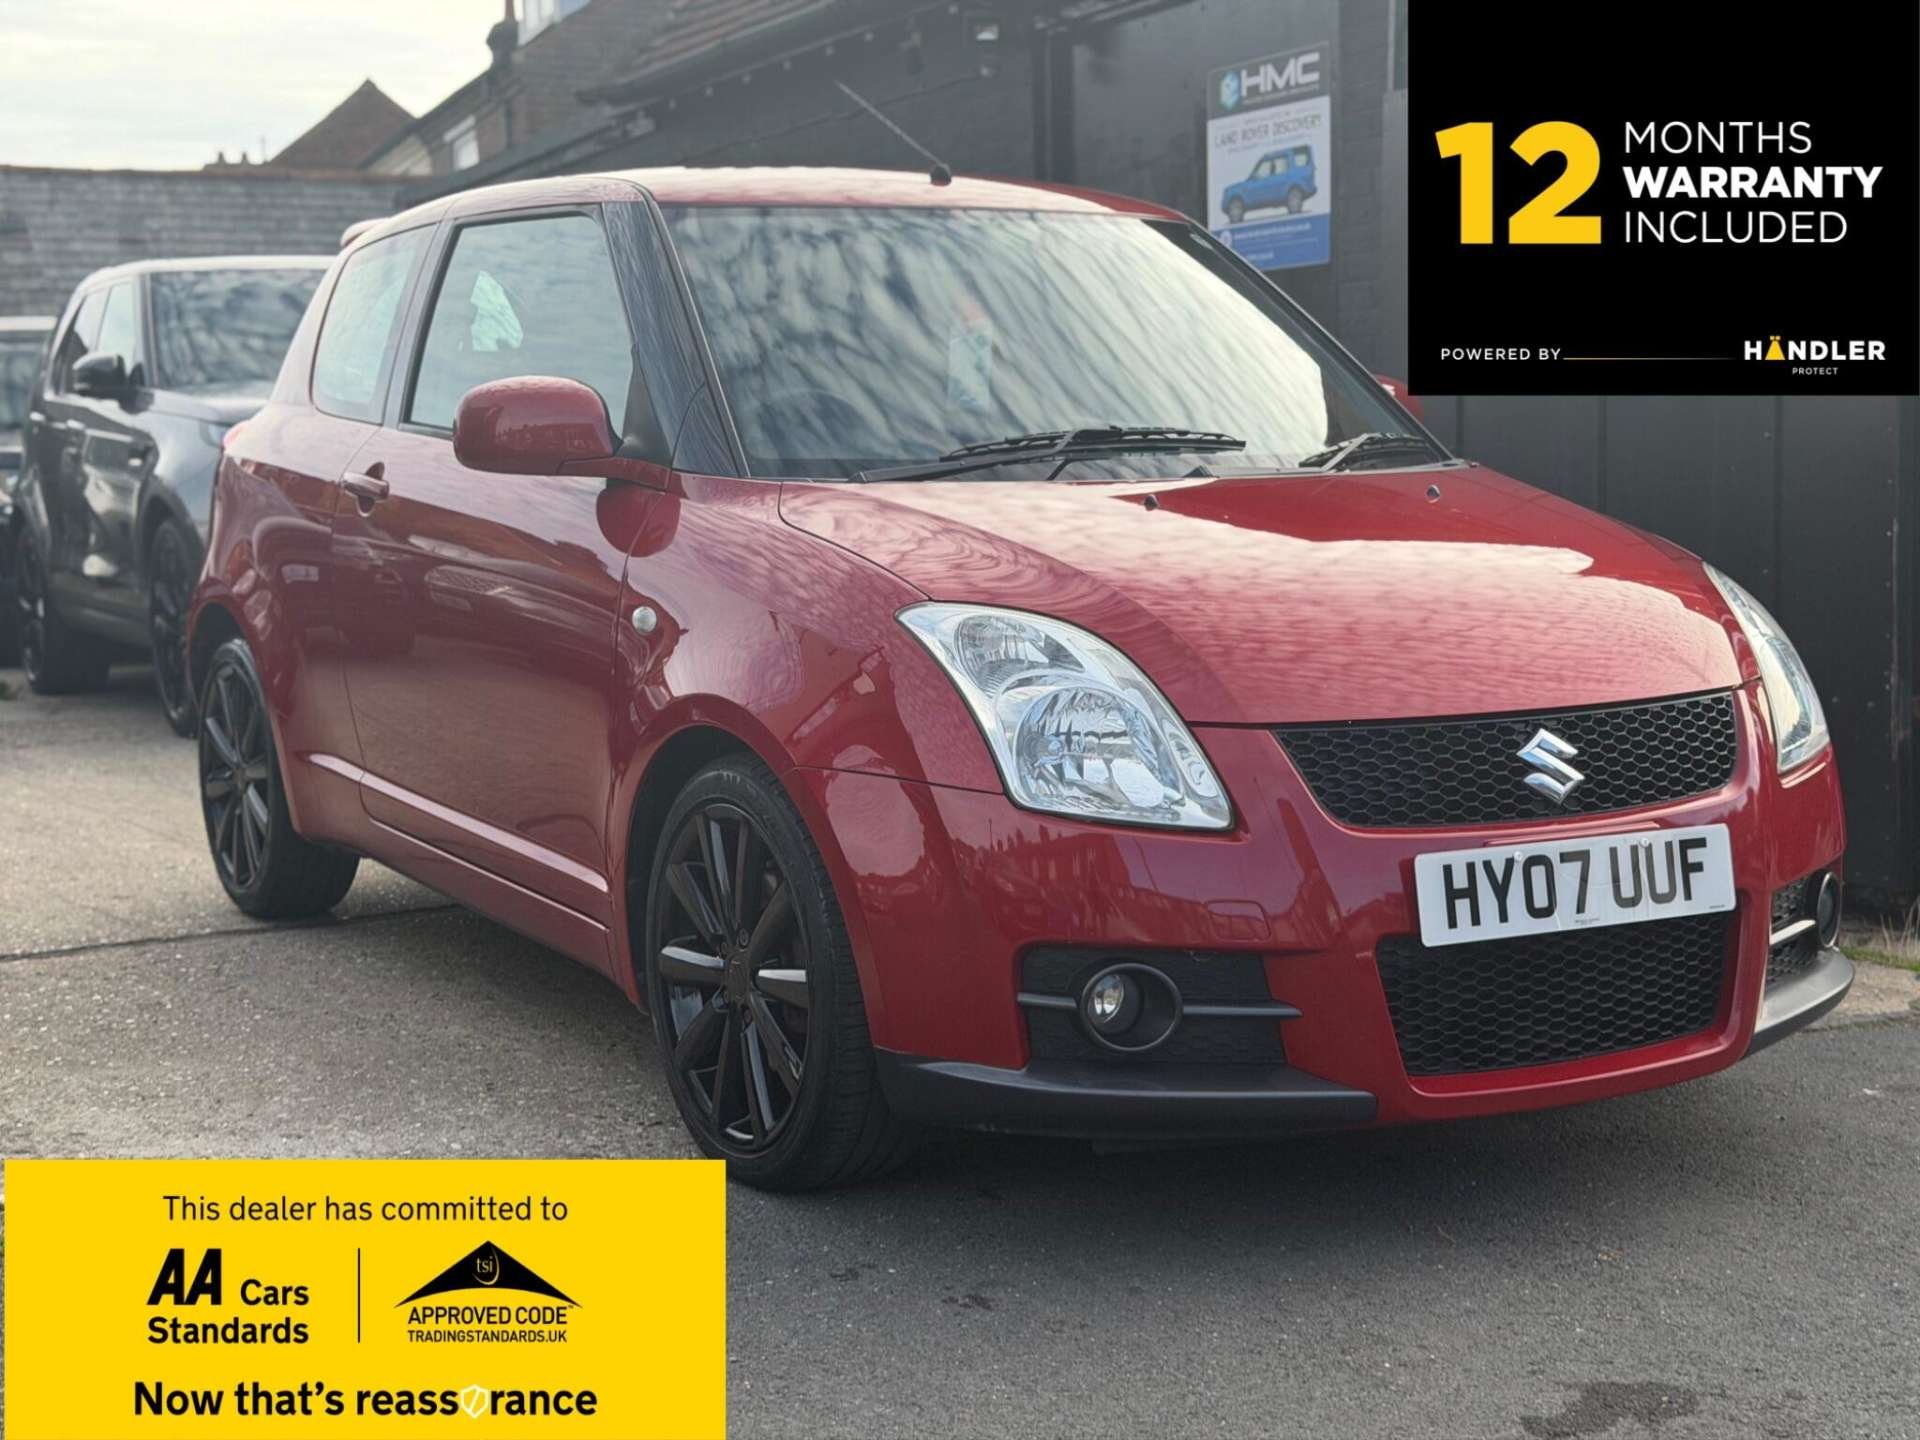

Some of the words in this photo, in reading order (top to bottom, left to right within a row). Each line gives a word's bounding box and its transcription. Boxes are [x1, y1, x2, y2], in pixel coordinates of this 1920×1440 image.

[1240, 52, 1320, 97] HMC
[1241, 122, 1270, 143] ROVER
[1442, 848, 1591, 930] HY07
[1608, 837, 1708, 909] UUF
